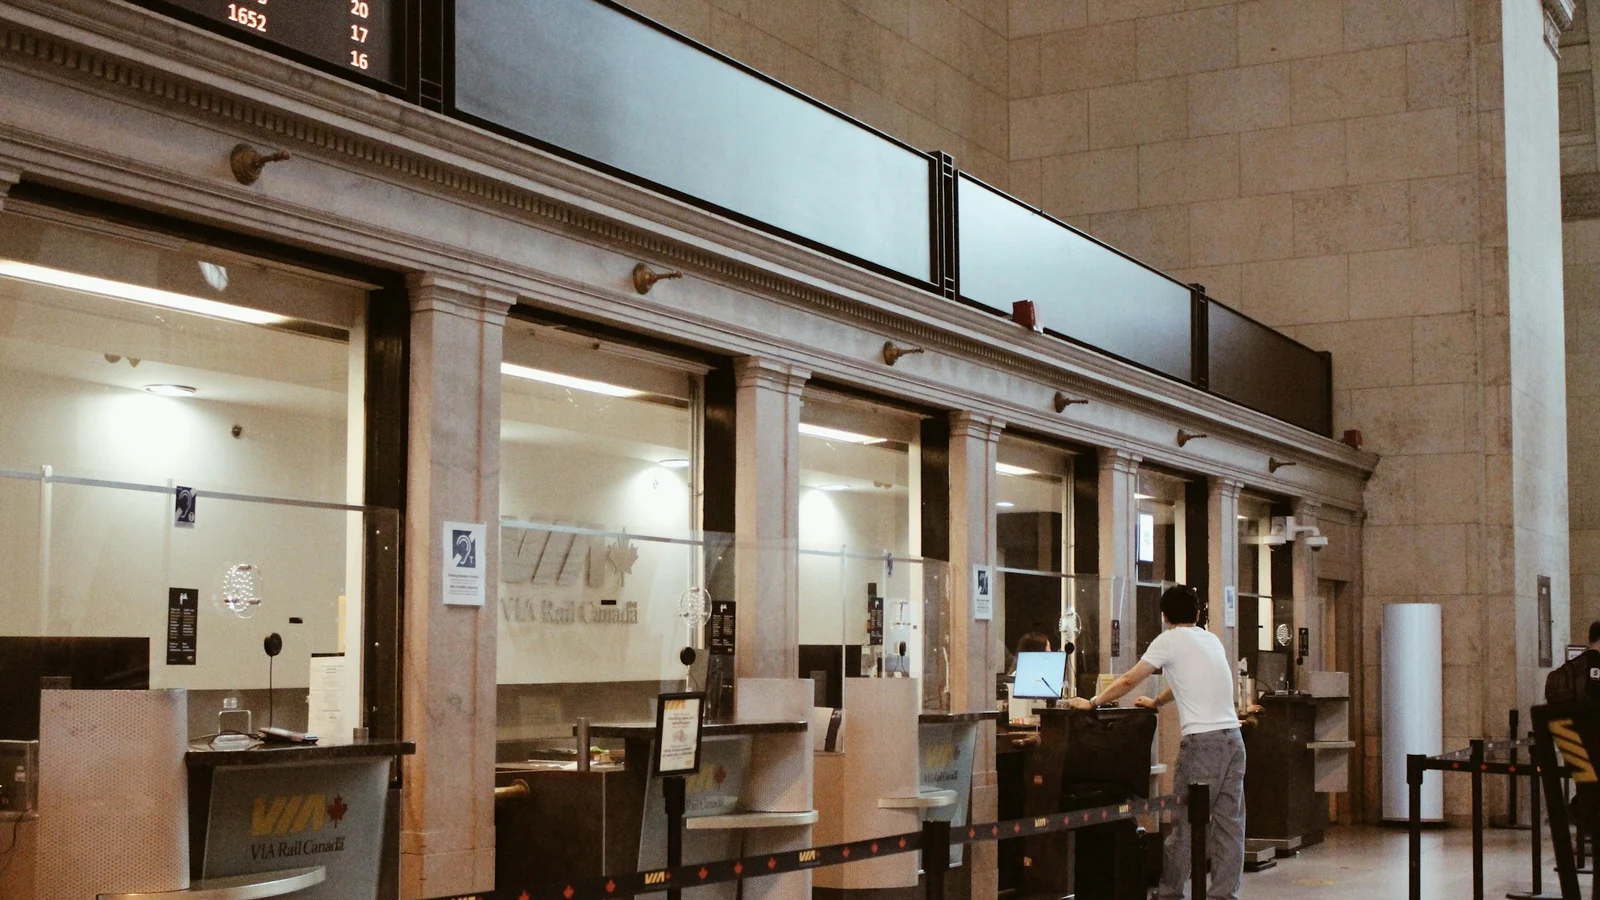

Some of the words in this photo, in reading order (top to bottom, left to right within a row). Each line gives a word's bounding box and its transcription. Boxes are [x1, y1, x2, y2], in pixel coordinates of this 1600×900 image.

[228, 4, 267, 32] 1652
[351, 0, 368, 18] 20
[350, 25, 368, 43] 17
[350, 50, 368, 70] 16
[541, 600, 576, 624] Rail
[579, 601, 639, 625] Canada
[251, 793, 326, 837] VIA
[251, 843, 276, 860] VIA
[279, 841, 302, 857] Rail
[303, 839, 345, 854] Canada
[799, 850, 815, 862] VIA
[645, 871, 665, 885] VIA
